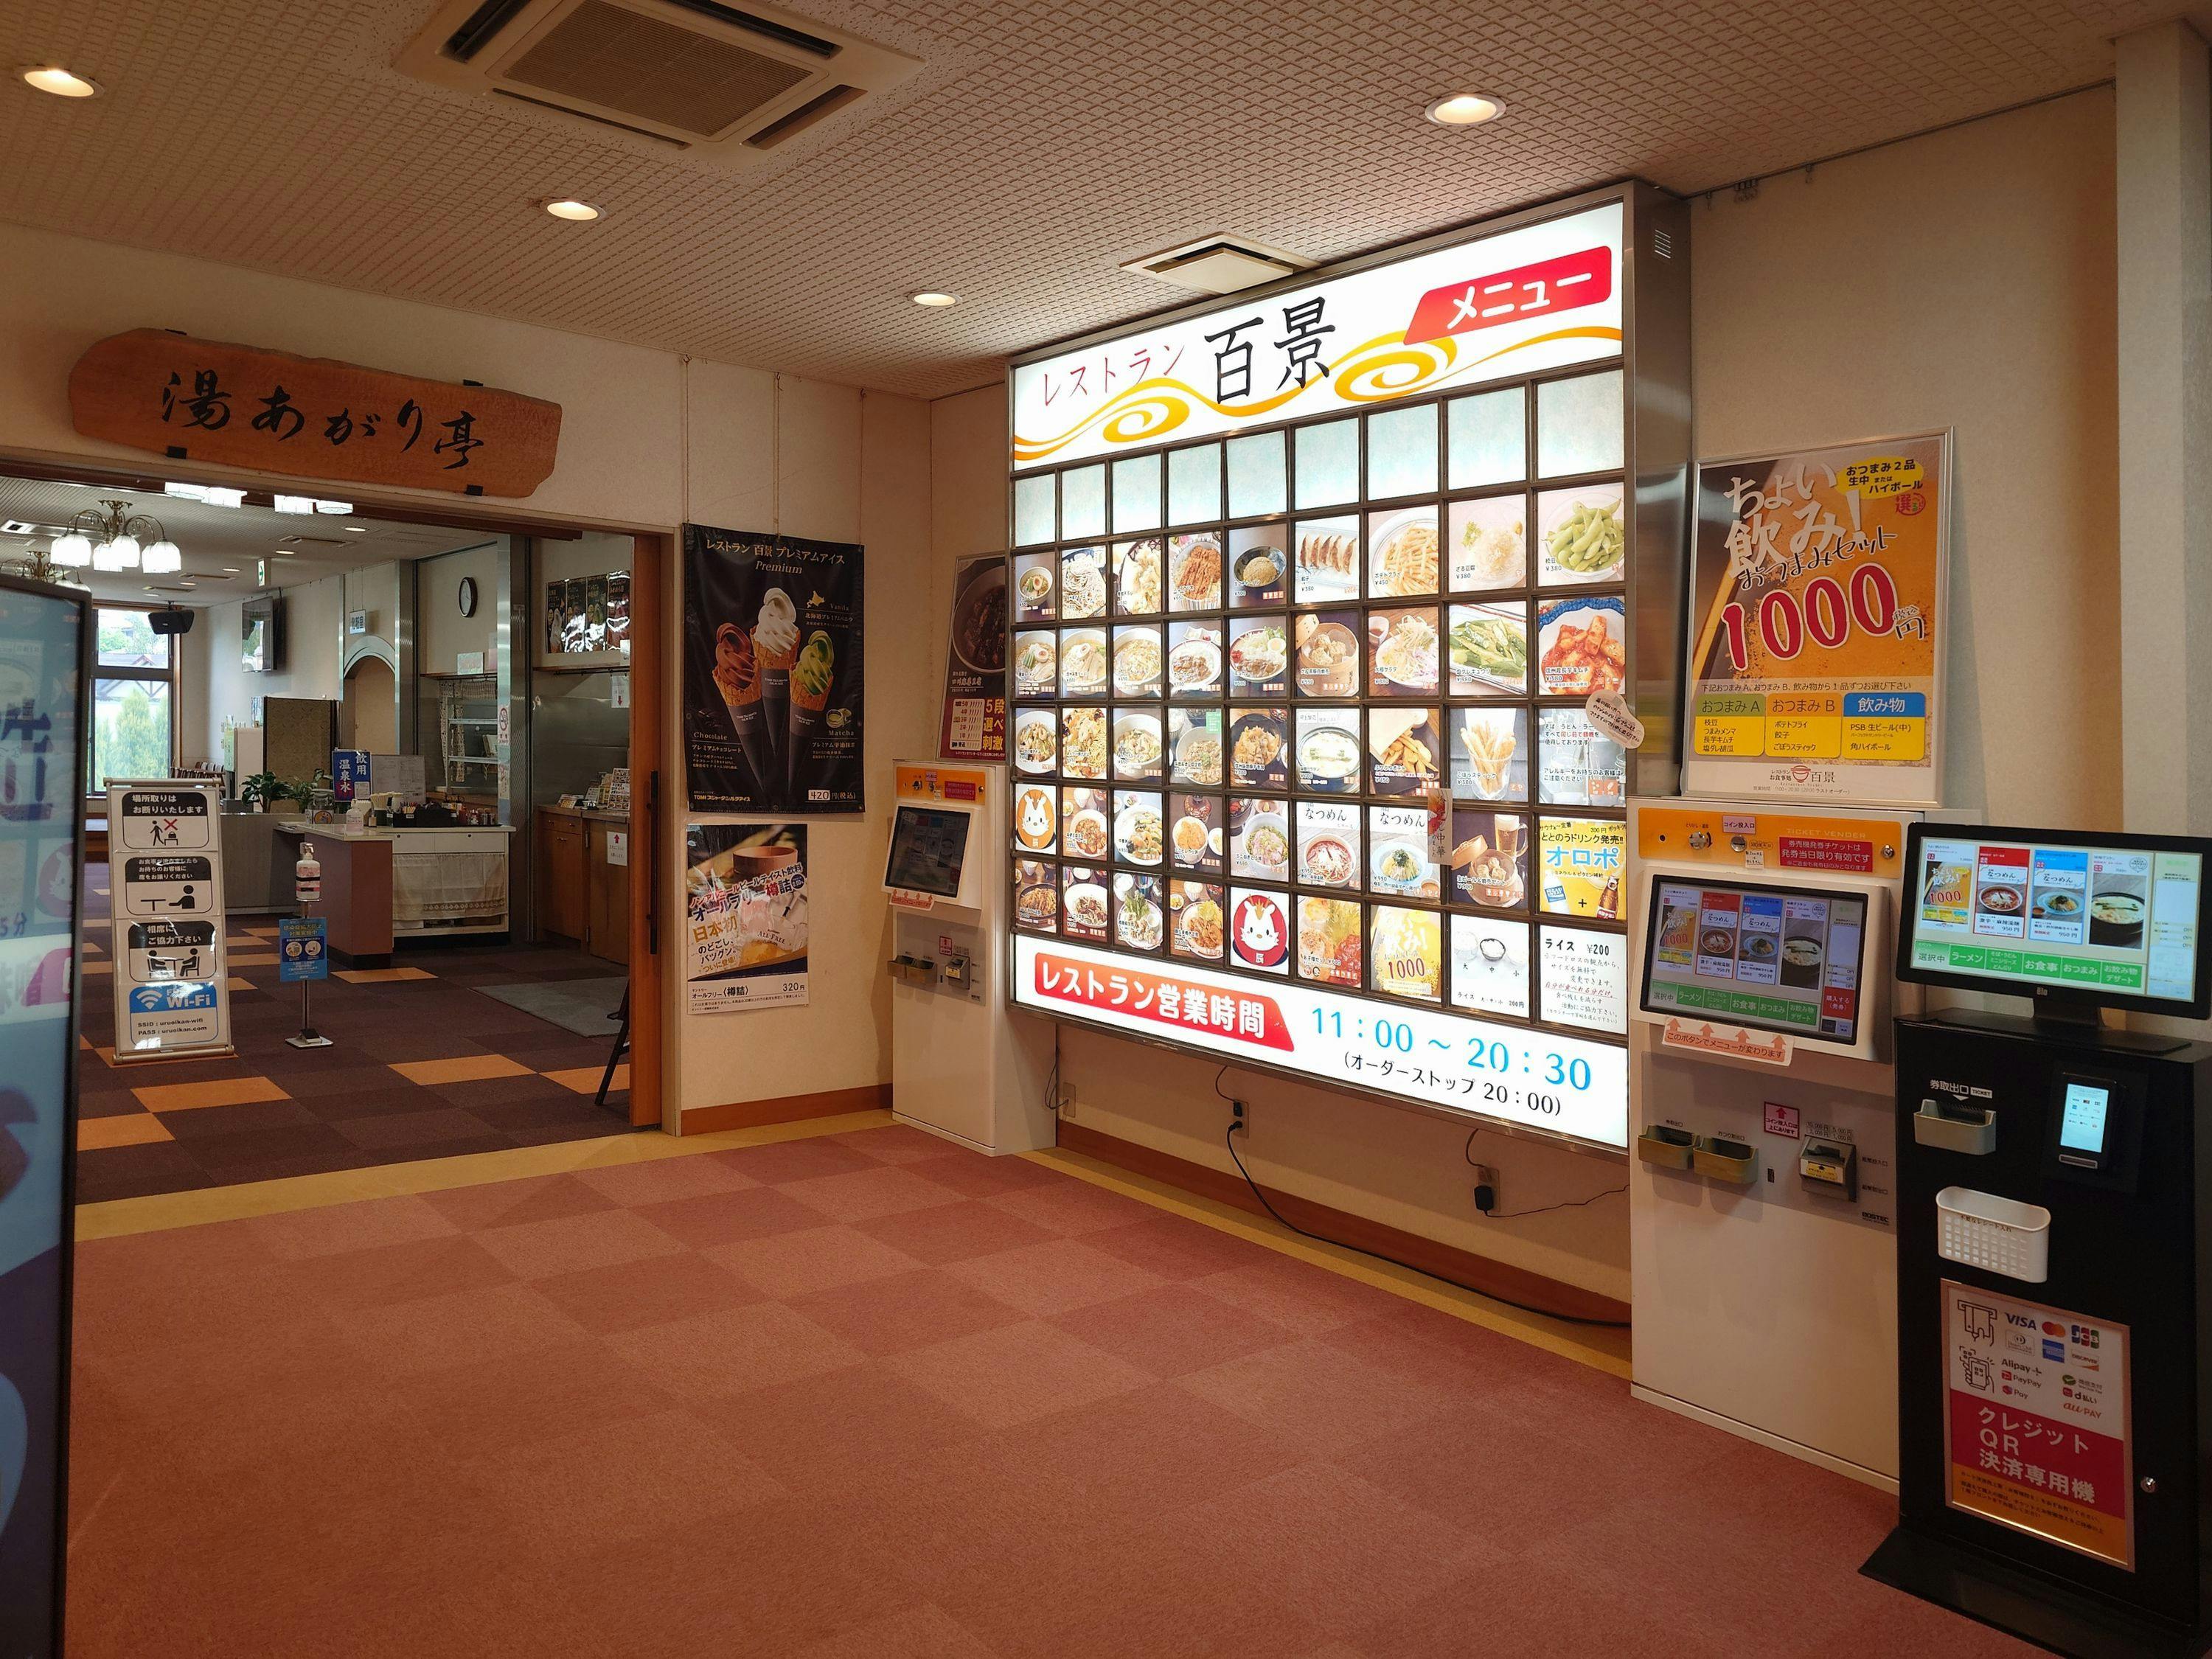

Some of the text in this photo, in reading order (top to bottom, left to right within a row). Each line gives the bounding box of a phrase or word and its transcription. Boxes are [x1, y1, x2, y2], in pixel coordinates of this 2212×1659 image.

[1447, 272, 1593, 330] メニュー
[1043, 296, 1336, 407] レストラン 百景
[161, 369, 484, 470] 湯あがり亭
[1848, 476, 1869, 486] 生中
[1869, 480, 1923, 493] ハイボール
[1723, 463, 1839, 515] ちょい
[1724, 490, 1868, 580] 飲み!
[706, 539, 846, 565] レストラン 百景 プレミアムアイス
[1739, 526, 1898, 591] おつまみセット
[755, 561, 802, 574] Premium
[830, 602, 849, 611] Vanilla
[1893, 606, 1920, 620] 税込
[1722, 562, 1896, 671] 1000
[1896, 617, 1925, 641] 円
[986, 698, 1006, 714] 5段
[1702, 700, 1760, 713] おつまみ A
[1773, 700, 1834, 712] おつまみ B
[1857, 698, 1905, 713] 飲み物
[984, 717, 1004, 732] 選べ
[1868, 723, 1911, 732] 生ビール(中)
[693, 731, 728, 740] Chocolate
[828, 728, 855, 737] Matcha
[1774, 731, 1790, 739] 餃子
[692, 744, 742, 753] プレミアムチョコレート
[983, 735, 1003, 751] 刺激
[1773, 743, 1816, 751] ごぼうスティック
[355, 753, 367, 775] 飲用
[339, 759, 352, 793] 温泉水
[1811, 771, 1835, 783] 百景
[132, 794, 177, 803] 場所取りは
[133, 805, 204, 815] お断りいたします
[1305, 807, 1347, 822] なつめん
[1380, 812, 1425, 827] なつめん
[1789, 841, 1861, 851] 券売機発券チケットは
[1546, 846, 1619, 869] オロポ
[1781, 849, 1870, 863] 発券当日限り有効です
[1987, 871, 2016, 879] なつめん
[2044, 874, 2073, 883] なつめん
[1930, 890, 1961, 904] 1000
[147, 924, 174, 933] 相席に
[693, 916, 737, 943] 日本初
[148, 935, 201, 945] ご協力下さい
[1545, 939, 1610, 956] ライス ¥200
[1918, 951, 1983, 963] 選択中 ラーメン
[1388, 958, 1425, 979] 1000
[2025, 961, 2058, 973] お食事
[2063, 965, 2098, 975] おつまみ
[2104, 966, 2138, 975] お飲み物
[2107, 975, 2133, 984] デザート
[782, 982, 805, 992] 320円
[166, 994, 211, 1009] Wi-Fi
[1042, 960, 1265, 1039] レストラン営業時間
[1458, 992, 1475, 1000] ライス
[1509, 1000, 1524, 1008] 200円
[1653, 991, 1702, 1001] 選択中 ラーメン
[1826, 995, 1850, 1004] 購入する
[1733, 998, 1757, 1010] お食事
[1760, 1003, 1785, 1013] おつまみ
[1790, 1004, 1815, 1013] お飲み物
[160, 1018, 204, 1026] uruoikan-wifi
[161, 1026, 207, 1034] uruoikan.com
[1311, 1007, 1592, 1091] 11:00 20:30
[1667, 1032, 1782, 1059] このボタンでメニューが変わります
[1345, 1051, 1561, 1116] (オーダーストップ 20:00)
[1930, 1079, 1991, 1097] 券取出口 TICKET
[1765, 1118, 1798, 1129] コイン投入口は
[1769, 1124, 1795, 1134] 上にあります
[2005, 1312, 2037, 1330] VISA
[2071, 1325, 2100, 1349] JCB
[2014, 1375, 2042, 1388] PayPay
[2014, 1388, 2028, 1399] Pay
[2075, 1392, 2097, 1404] d払い
[2063, 1402, 2102, 1419] au PAY
[1978, 1406, 2089, 1455] クレジット
[1980, 1430, 2020, 1456] QR
[1980, 1448, 2096, 1504] 決済専用機
